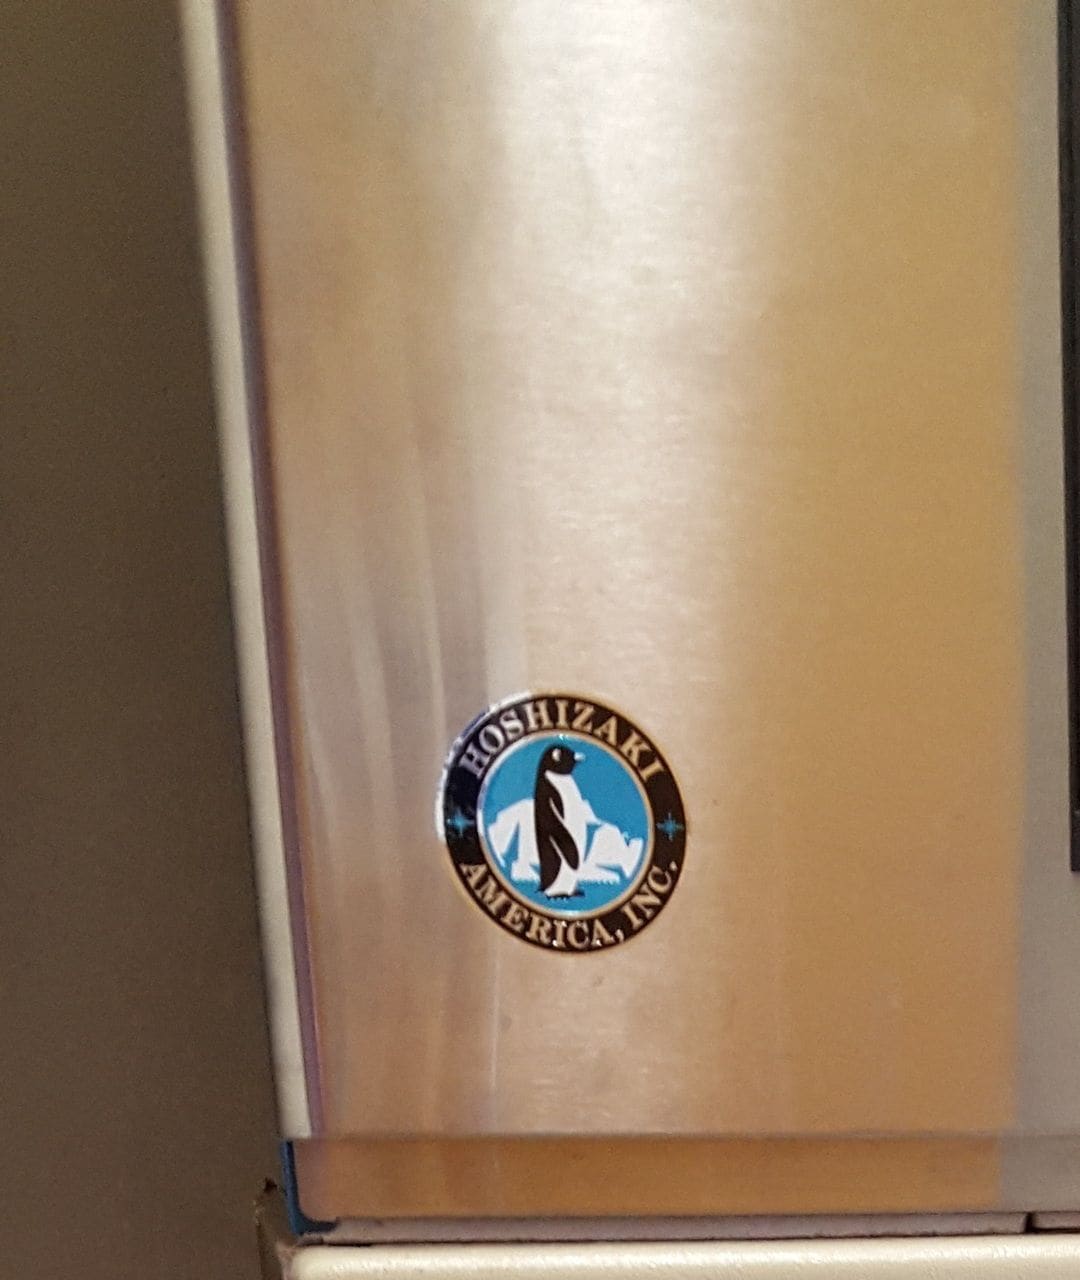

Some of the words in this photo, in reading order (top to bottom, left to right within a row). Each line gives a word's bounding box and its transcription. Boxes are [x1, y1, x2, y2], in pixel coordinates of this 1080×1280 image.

[459, 698, 665, 783] HOSHIZAKI
[460, 863, 625, 950] AMERICA,
[624, 861, 678, 928] INC.
